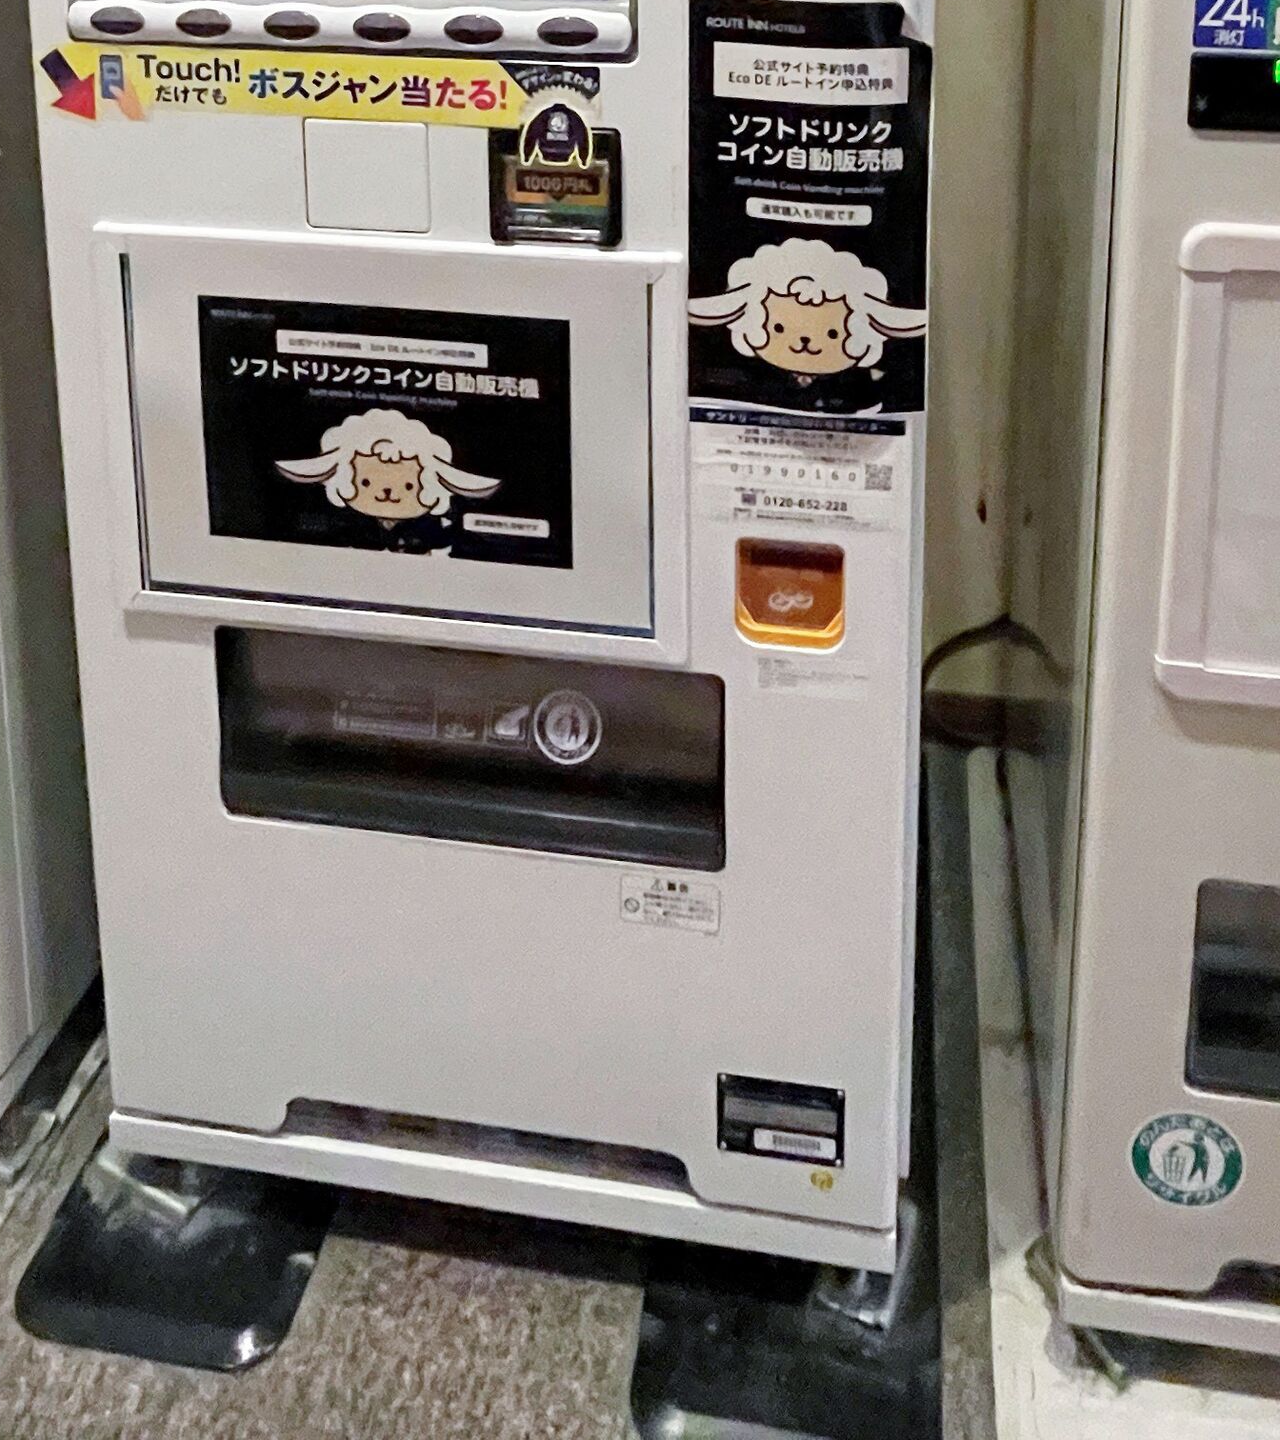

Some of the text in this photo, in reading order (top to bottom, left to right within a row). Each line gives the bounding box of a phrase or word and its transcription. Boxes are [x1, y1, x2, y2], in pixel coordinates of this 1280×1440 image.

[136, 53, 241, 84] Touch!
[728, 71, 894, 92] Eco DE ルートイン申込特典
[752, 58, 869, 77] 公式サイト予約特典
[154, 83, 228, 106] だけでも
[247, 65, 509, 112] ボスジャン当たる!
[728, 112, 893, 144] ソフトドリンク
[717, 140, 905, 173] コイン自動販売機
[229, 355, 541, 400] ソフトドリンクコイン自動販売機
